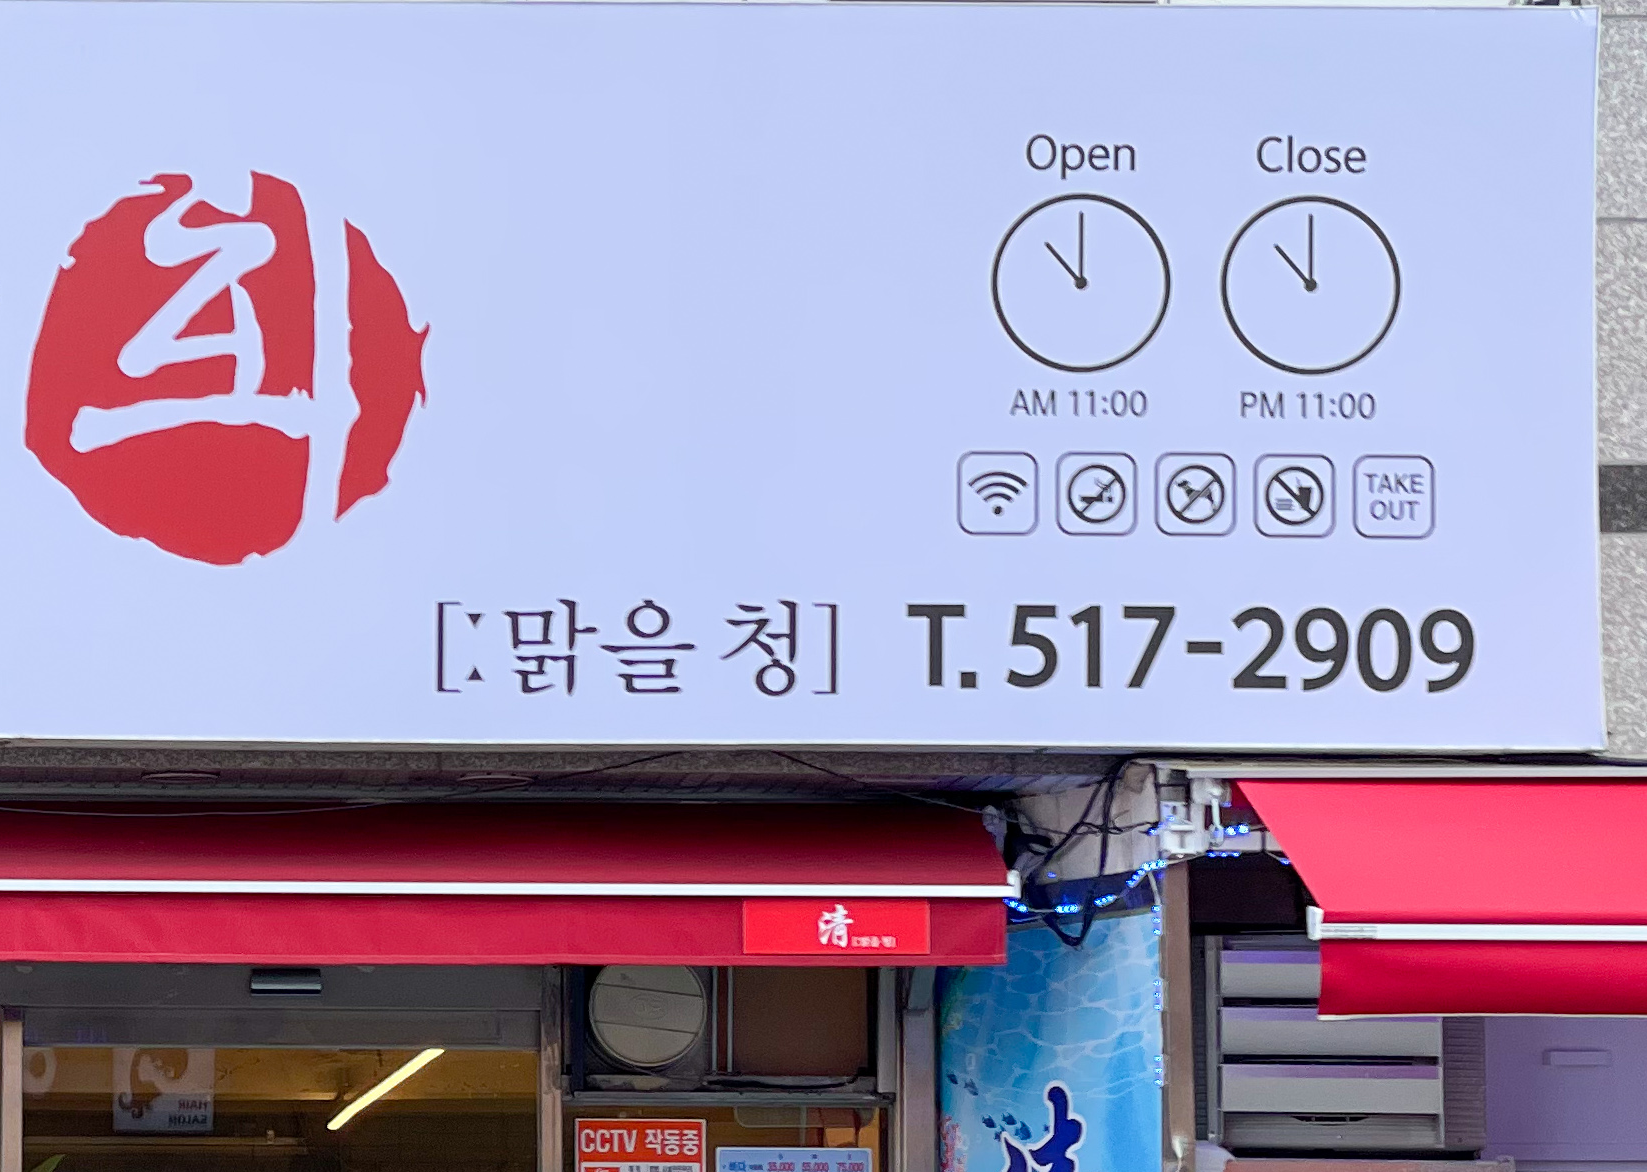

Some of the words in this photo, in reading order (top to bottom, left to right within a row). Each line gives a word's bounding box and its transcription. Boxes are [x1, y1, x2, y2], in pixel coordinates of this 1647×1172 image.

[1026, 134, 1135, 180] Open
[1257, 135, 1366, 173] Close
[1011, 390, 1056, 415] AM
[1072, 391, 1146, 416] 11:00
[1241, 392, 1284, 418] PM
[1298, 393, 1375, 419] 11:00
[1366, 474, 1423, 494] TAKE
[1371, 501, 1418, 520] OUT
[907, 604, 977, 689] T.
[1007, 605, 1474, 693] 517-2909
[581, 1129, 637, 1153] CCTV
[645, 1129, 698, 1155] 작동중
